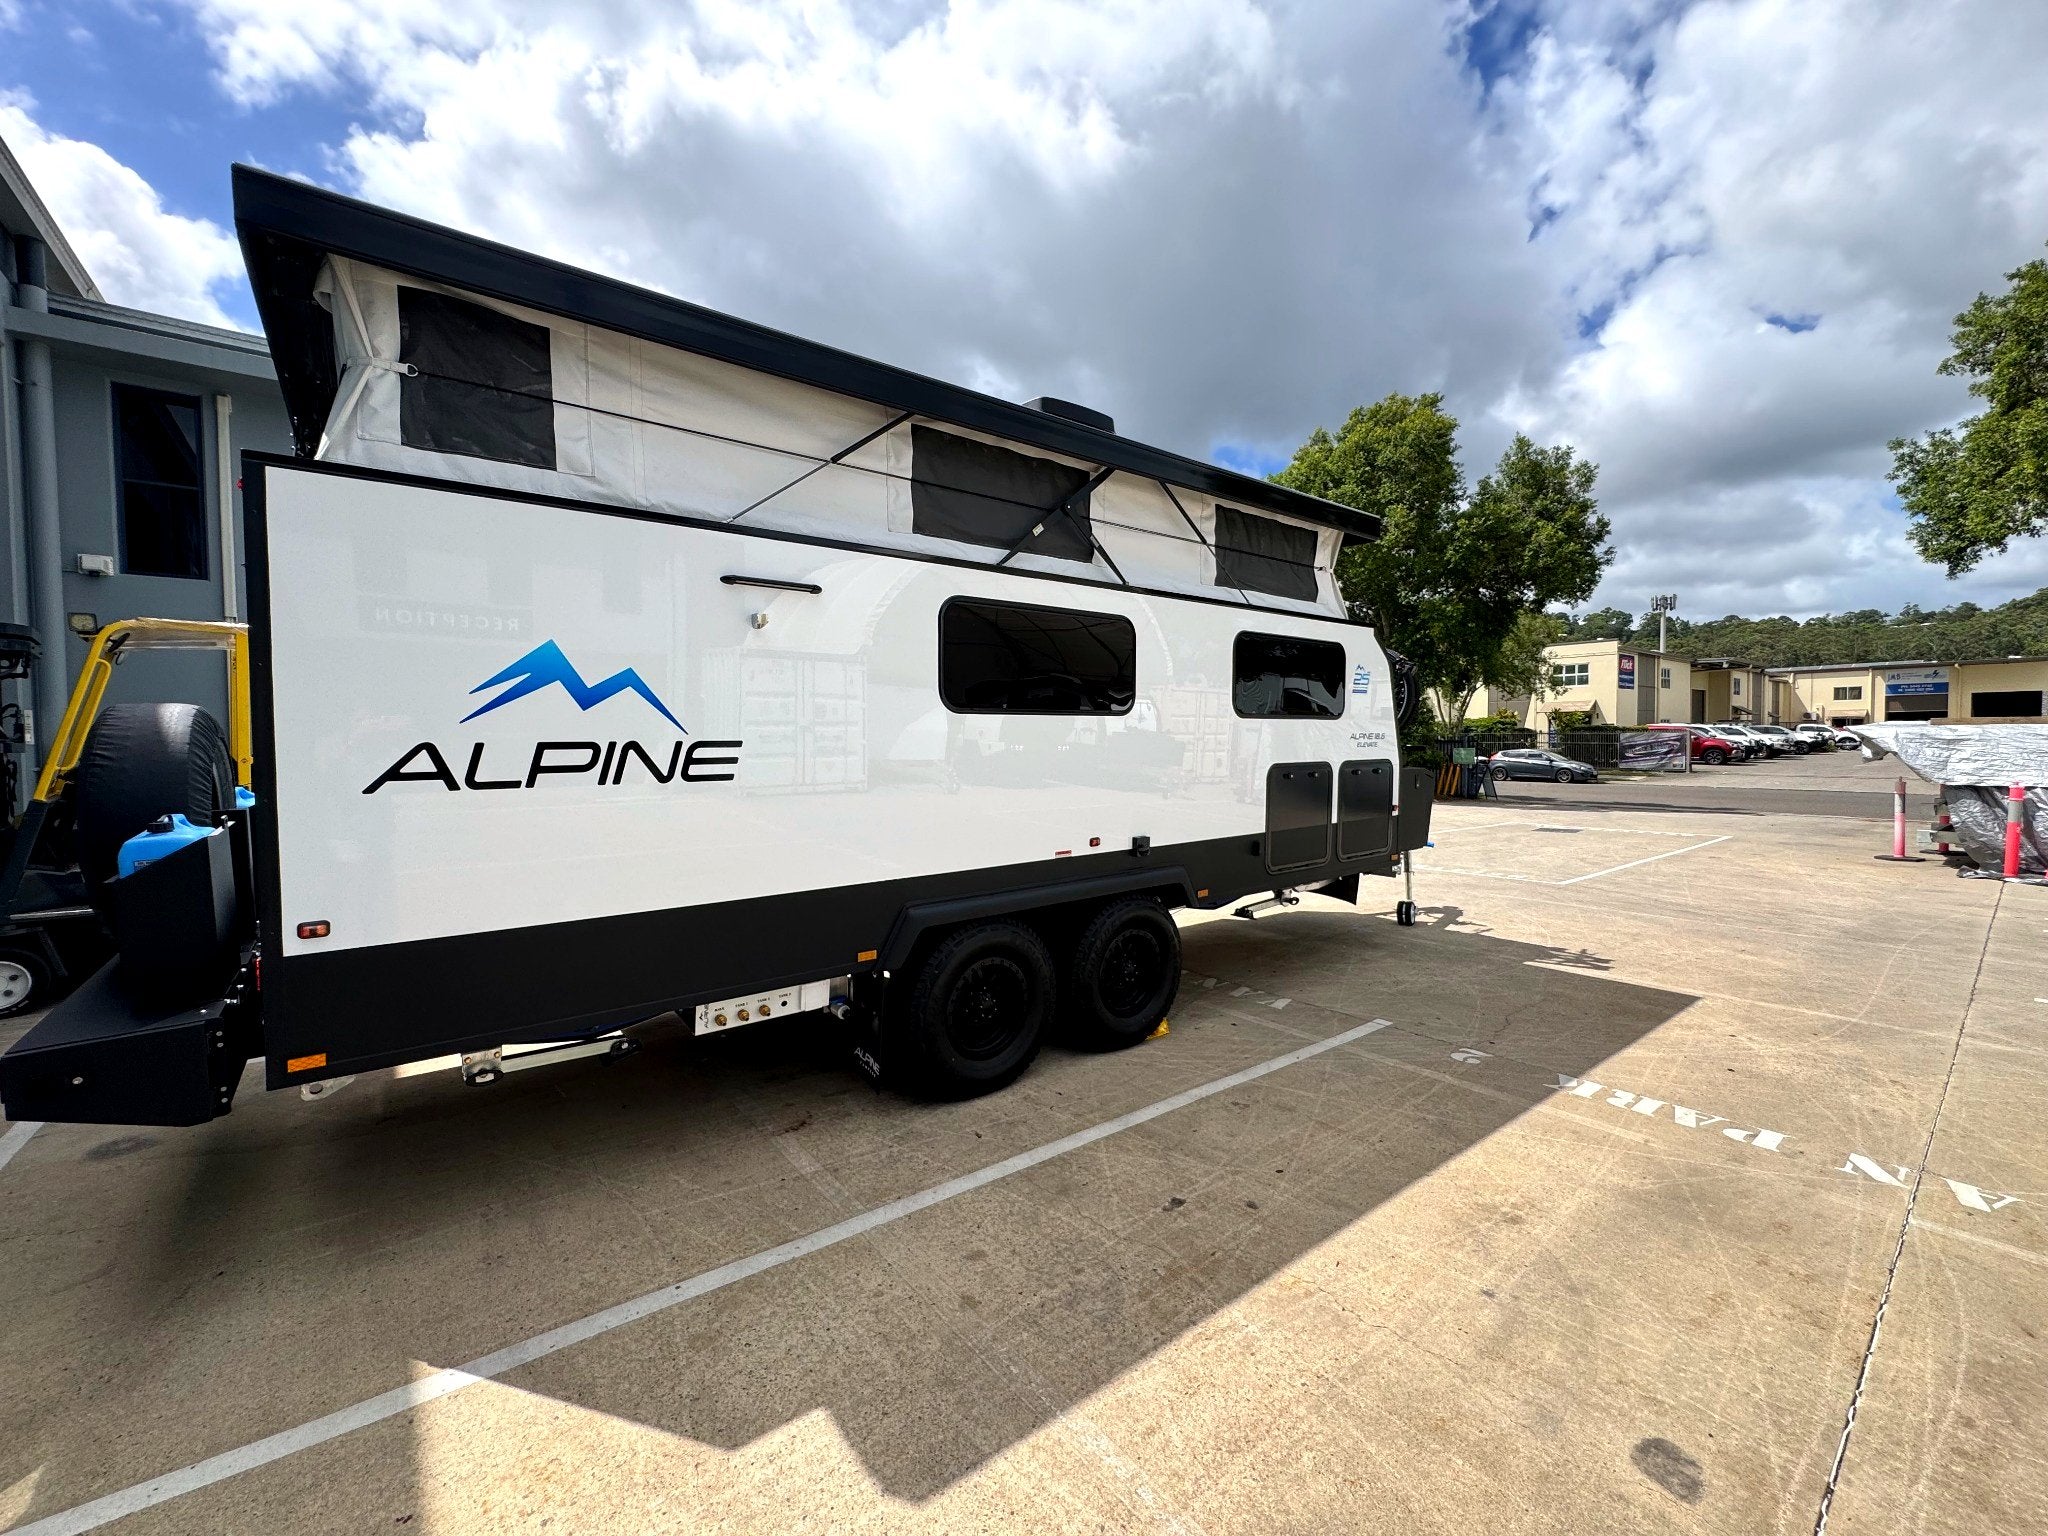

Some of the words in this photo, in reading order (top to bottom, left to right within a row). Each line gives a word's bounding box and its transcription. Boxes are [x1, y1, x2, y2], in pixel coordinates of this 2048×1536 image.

[362, 740, 743, 794] ALPINE
[854, 1047, 880, 1075] ALPINE
[1450, 1047, 1495, 1065] 2
[1543, 1073, 1796, 1153] PARK
